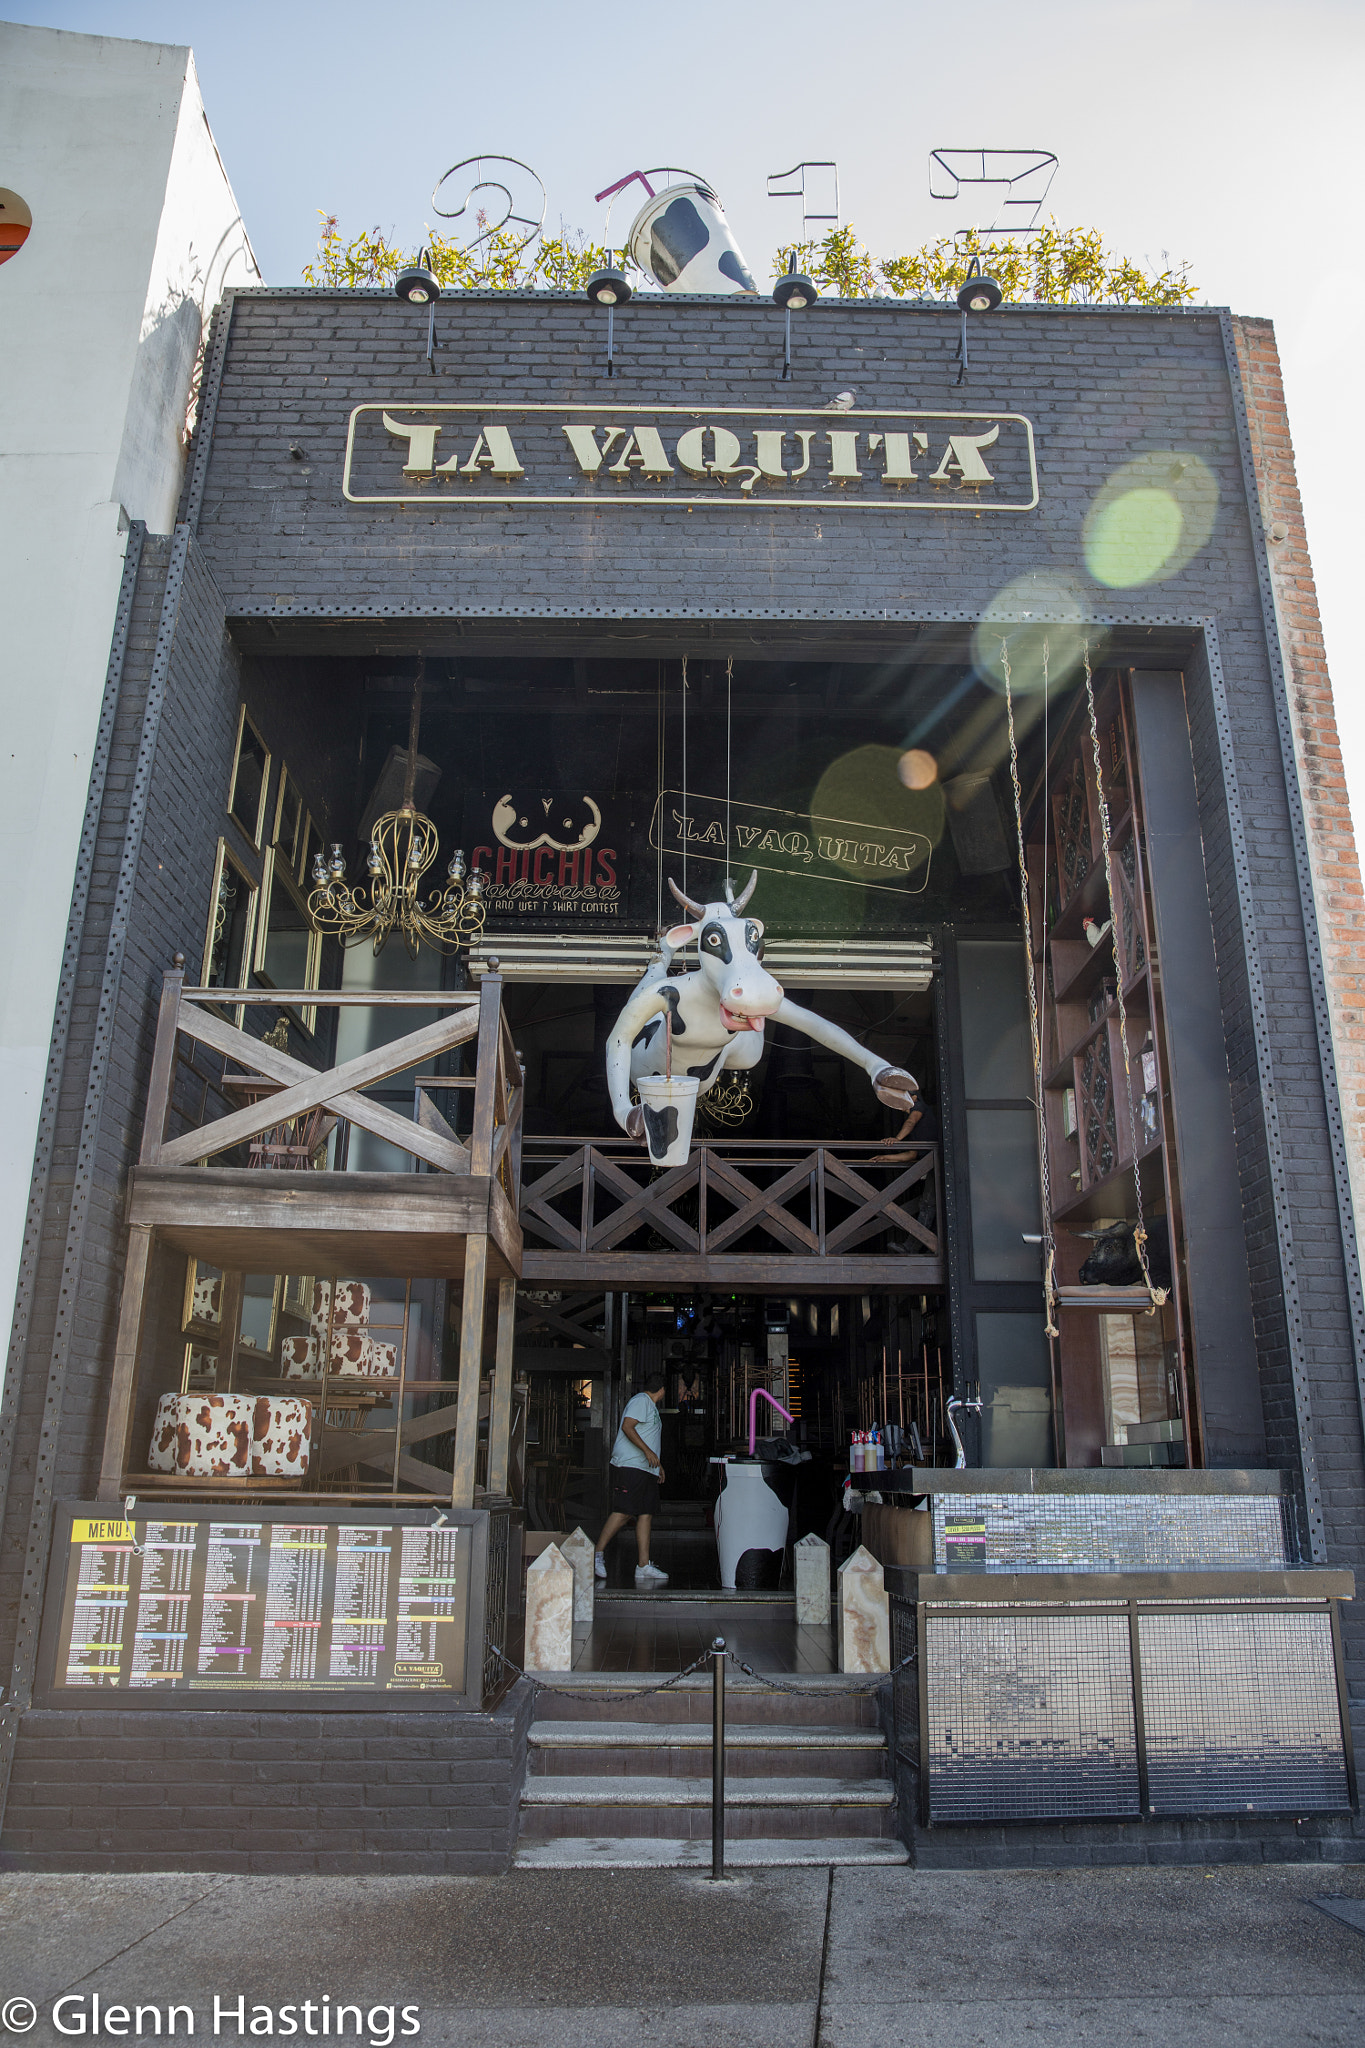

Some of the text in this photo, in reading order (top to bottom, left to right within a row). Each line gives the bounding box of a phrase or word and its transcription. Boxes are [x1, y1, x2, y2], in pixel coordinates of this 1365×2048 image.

[383, 411, 999, 490] LA VAQUITA
[672, 809, 916, 871] LA VAQUITA
[472, 846, 617, 887] CHICHIS
[519, 901, 538, 911] WET
[581, 902, 619, 914] CONTEST
